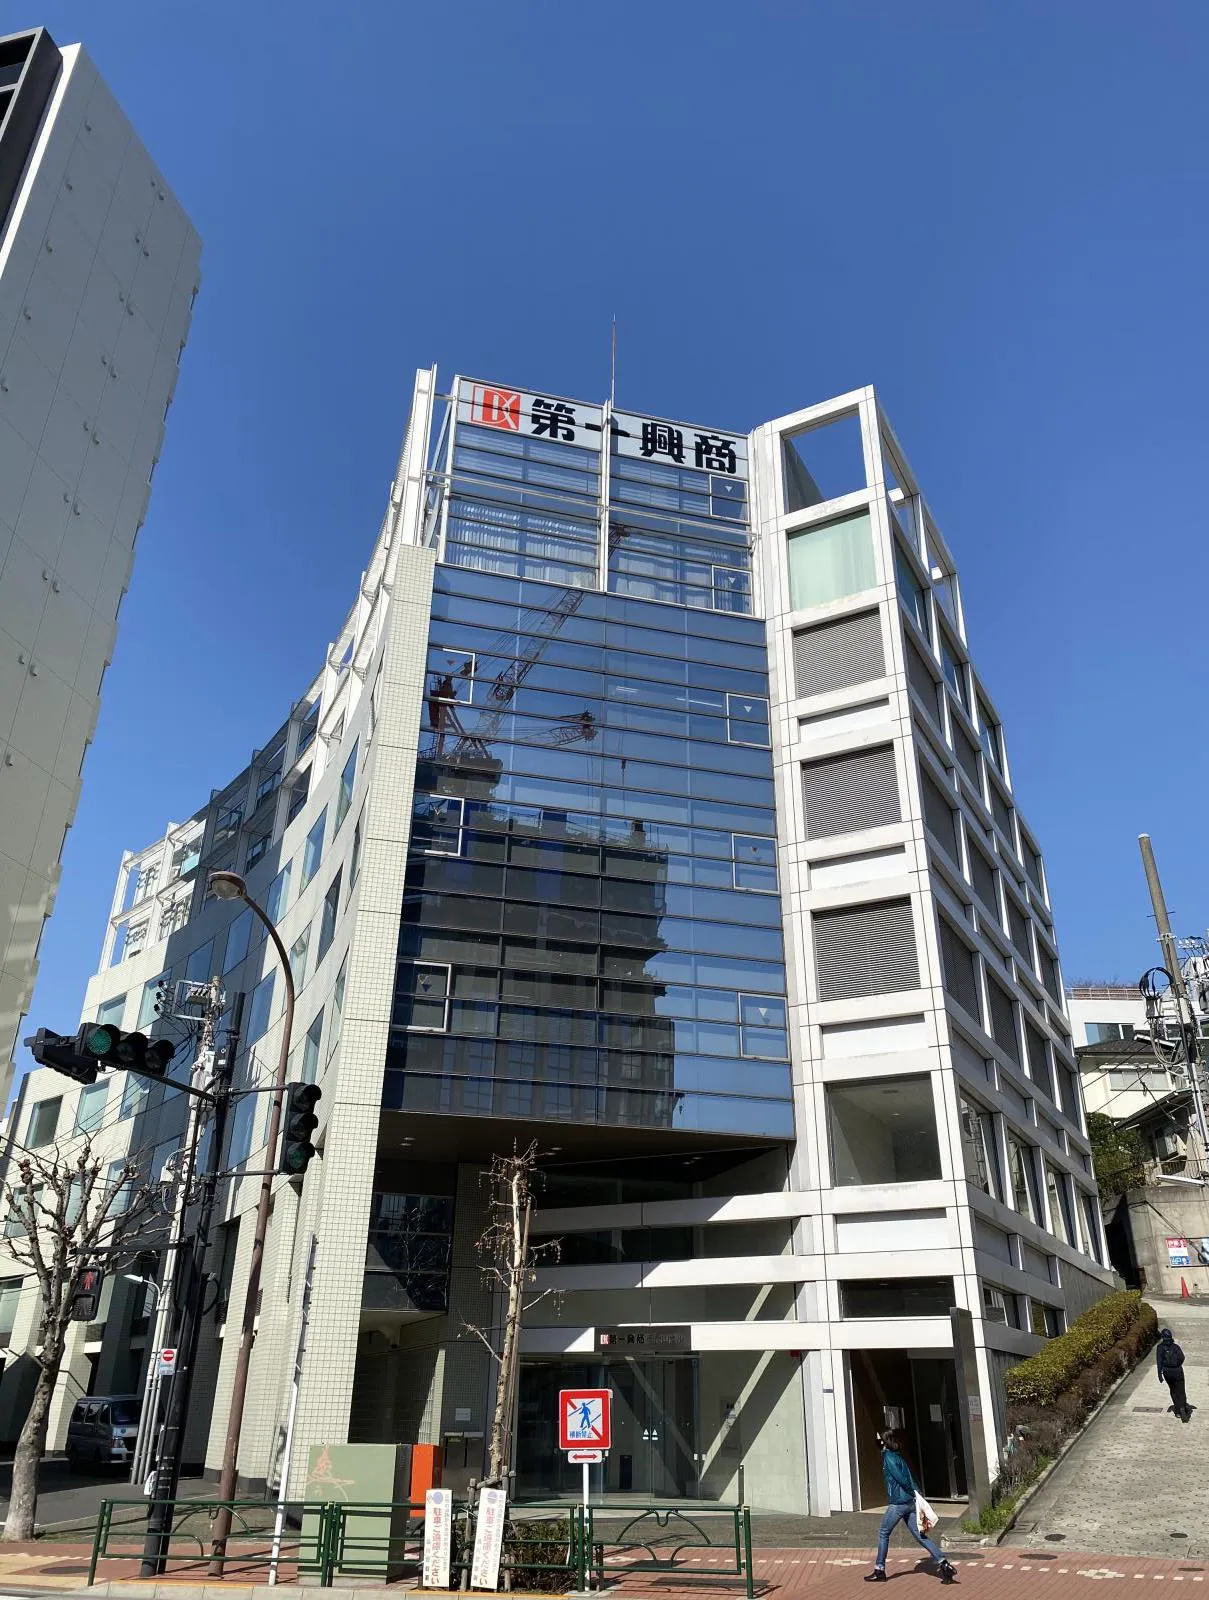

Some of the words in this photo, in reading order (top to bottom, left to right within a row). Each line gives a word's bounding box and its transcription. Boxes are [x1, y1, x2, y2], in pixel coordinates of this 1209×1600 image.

[531, 398, 737, 475] 第一興商
[569, 1430, 594, 1439] 横断禁止
